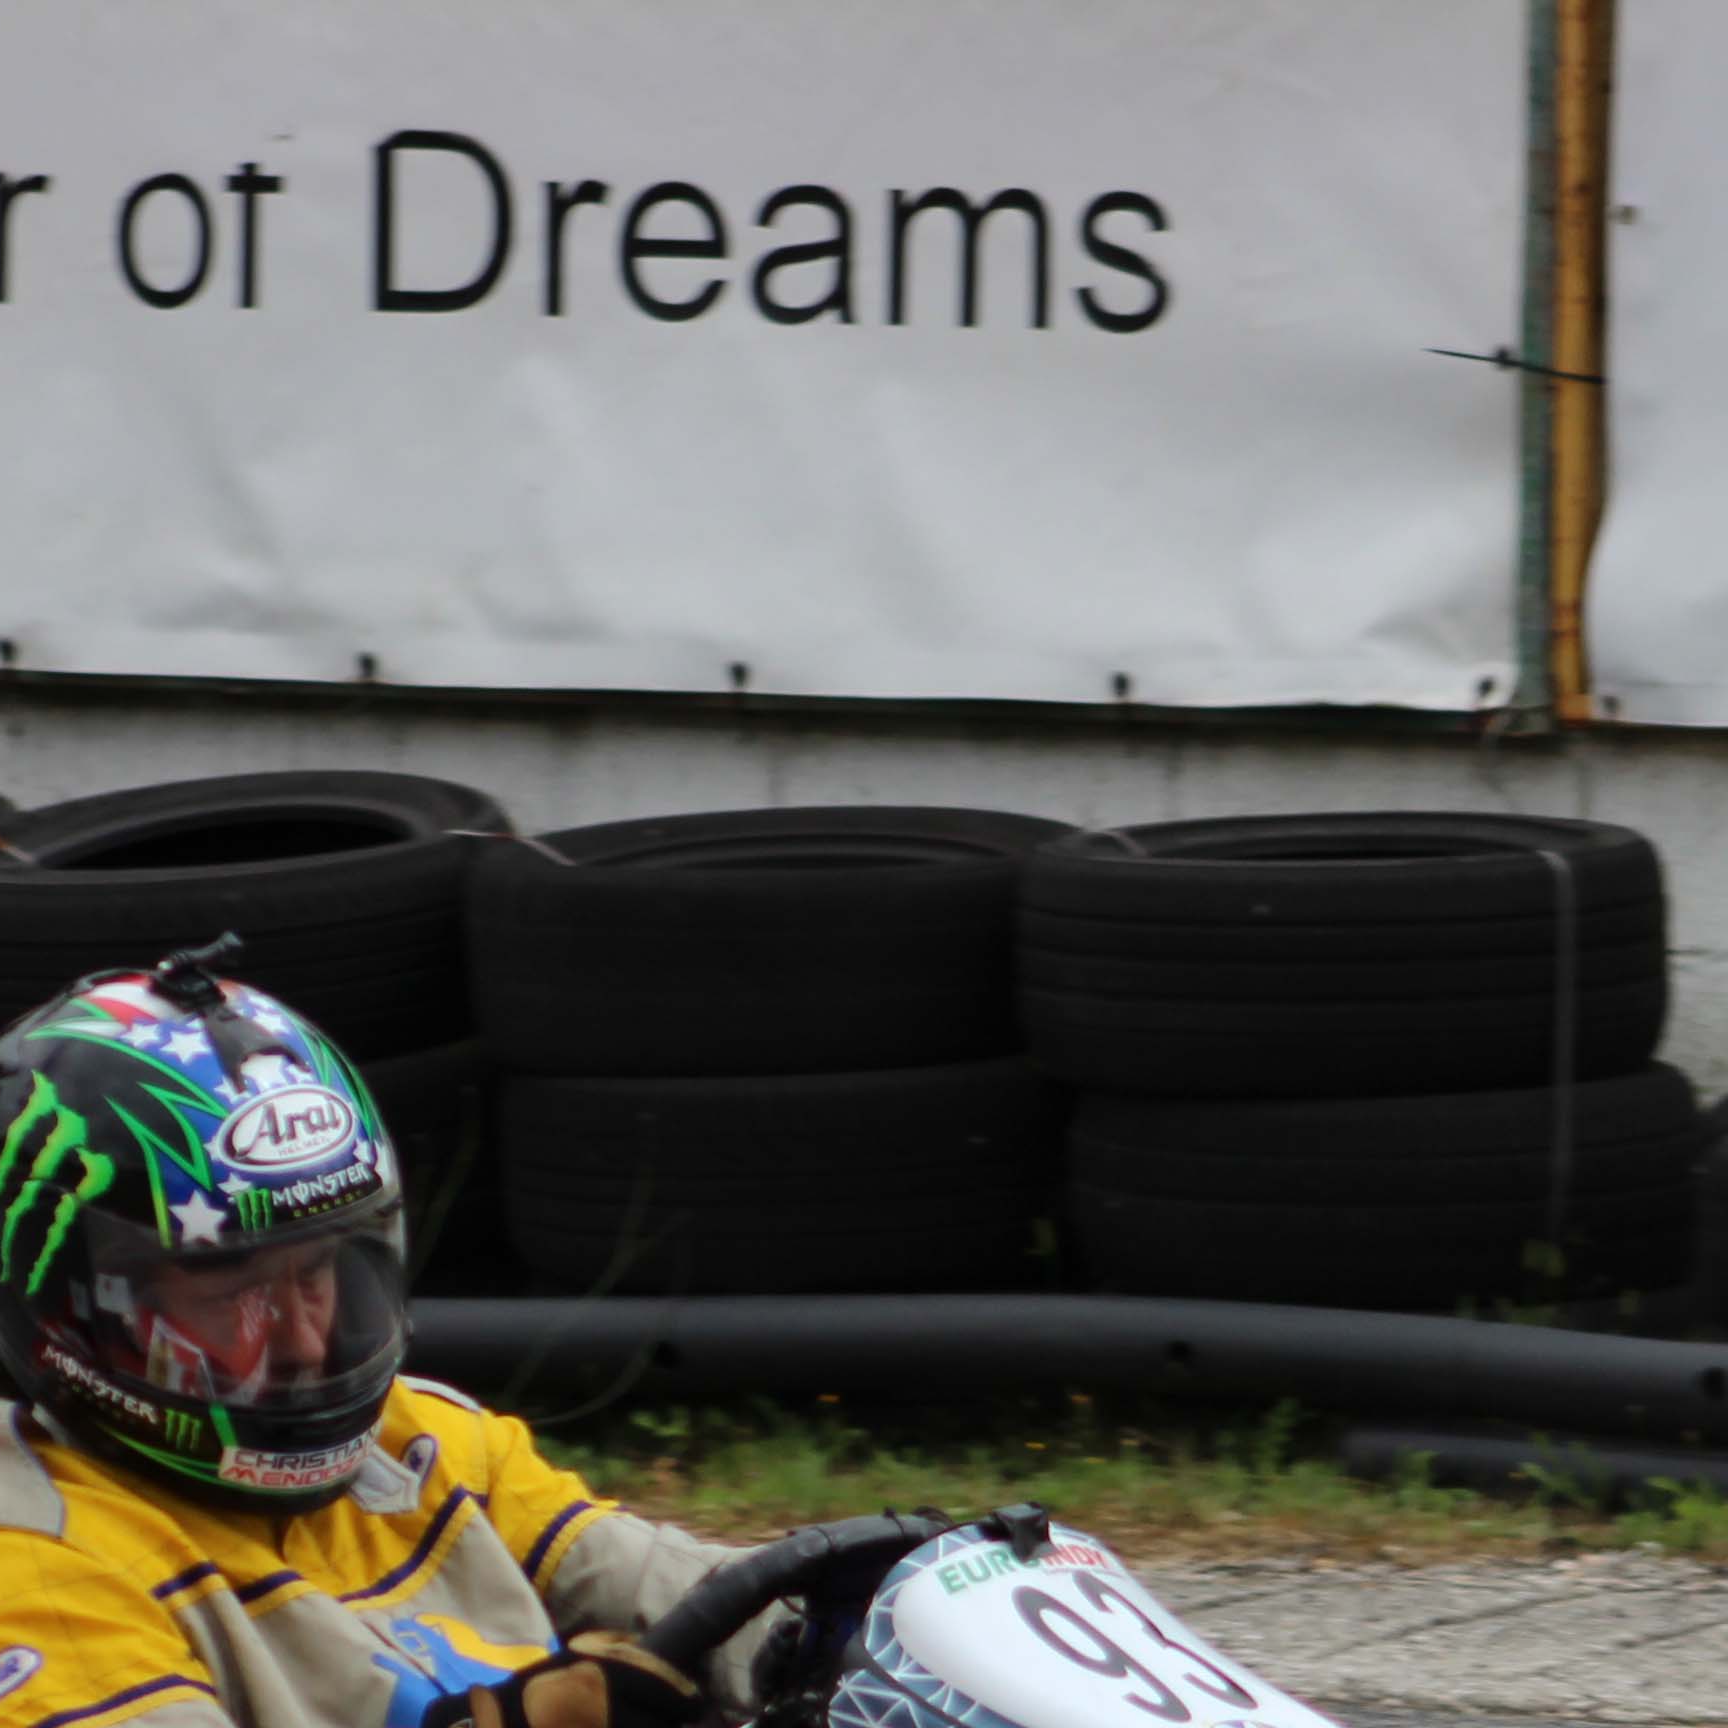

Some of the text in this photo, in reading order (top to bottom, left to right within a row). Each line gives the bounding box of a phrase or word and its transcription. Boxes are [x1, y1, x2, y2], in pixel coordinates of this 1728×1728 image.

[369, 129, 1172, 335] Dreams
[230, 1101, 341, 1158] Arai
[272, 1162, 373, 1207] MONSTER
[41, 1345, 159, 1425] MONSTER
[1013, 1571, 1258, 1723] 93
